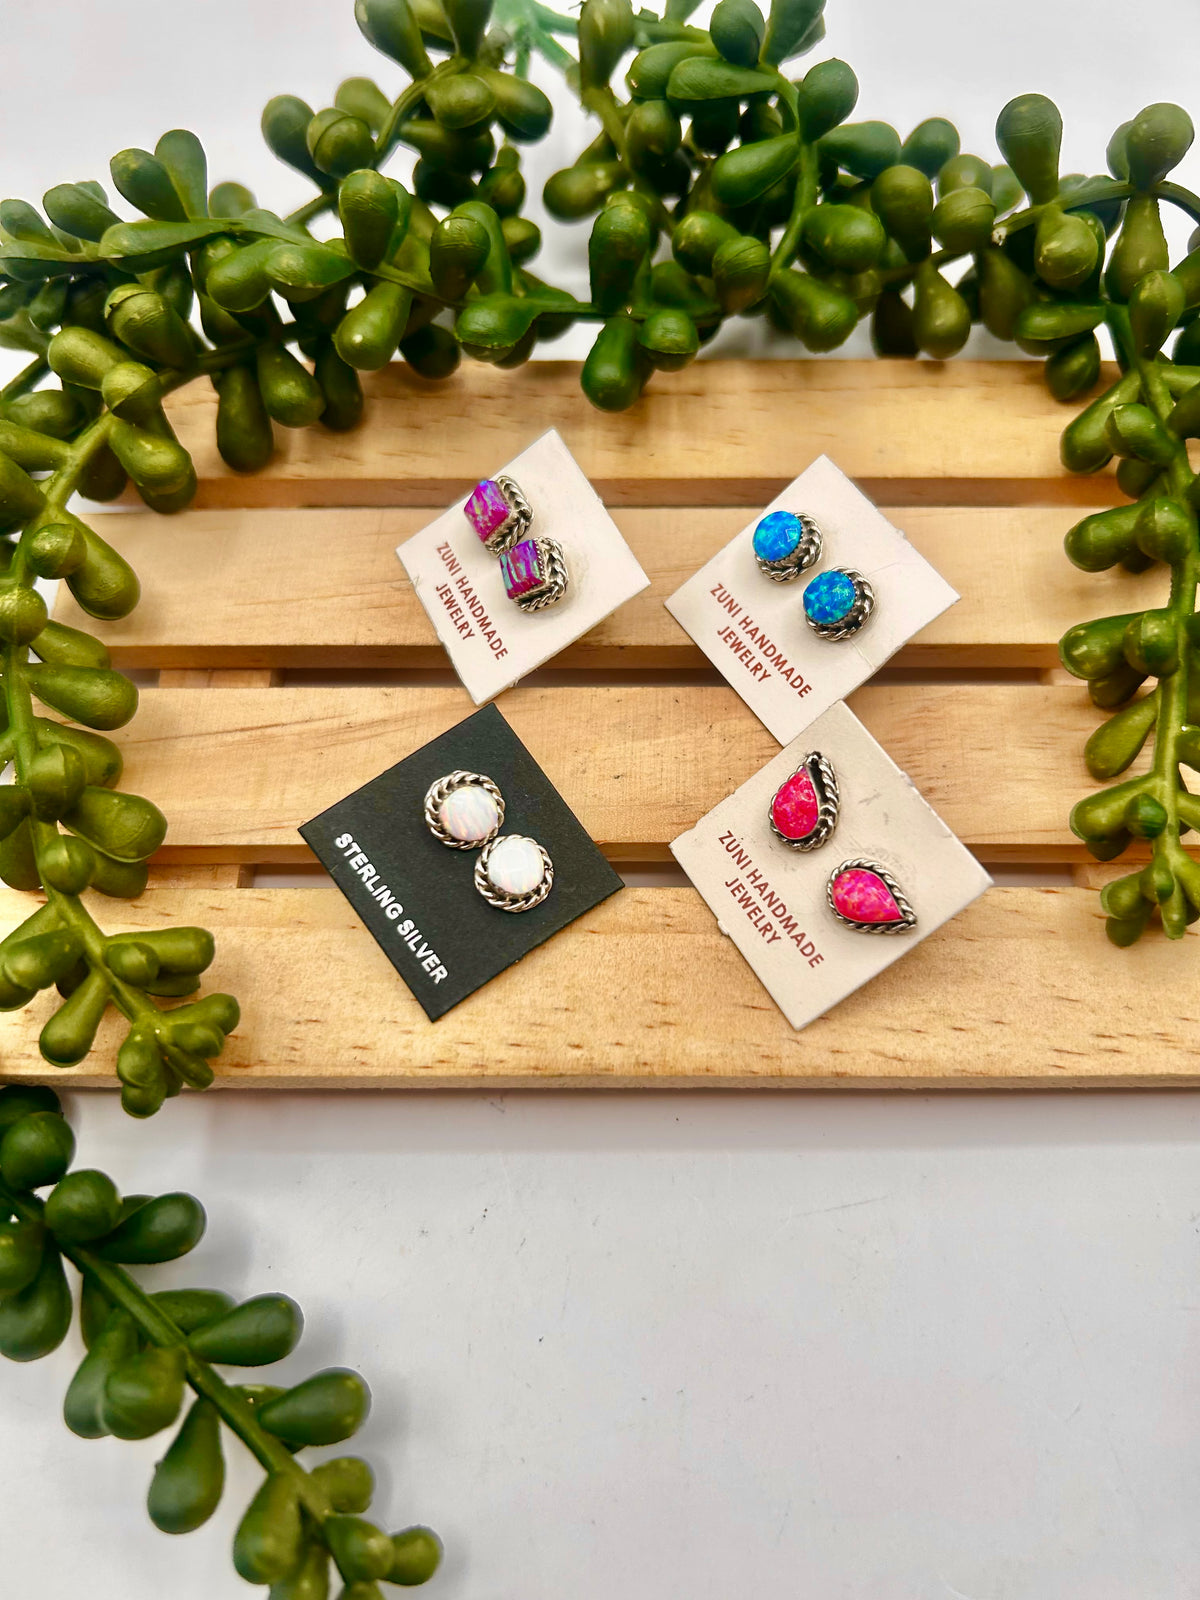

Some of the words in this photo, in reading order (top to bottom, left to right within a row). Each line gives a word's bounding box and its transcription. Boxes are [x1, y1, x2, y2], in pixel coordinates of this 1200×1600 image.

[435, 541, 462, 577] ZUNI
[455, 576, 508, 661] HANDMADE
[435, 583, 476, 641] JEWELRY
[710, 583, 742, 618] ZUNI
[738, 615, 812, 698] HANDMADE
[717, 626, 771, 683] JEWELRY
[335, 832, 403, 921] STERLING
[397, 919, 449, 985] SILVER
[718, 830, 752, 871] ZUNI
[746, 868, 824, 968] HANDMADE
[725, 878, 781, 945] JEWELRY
